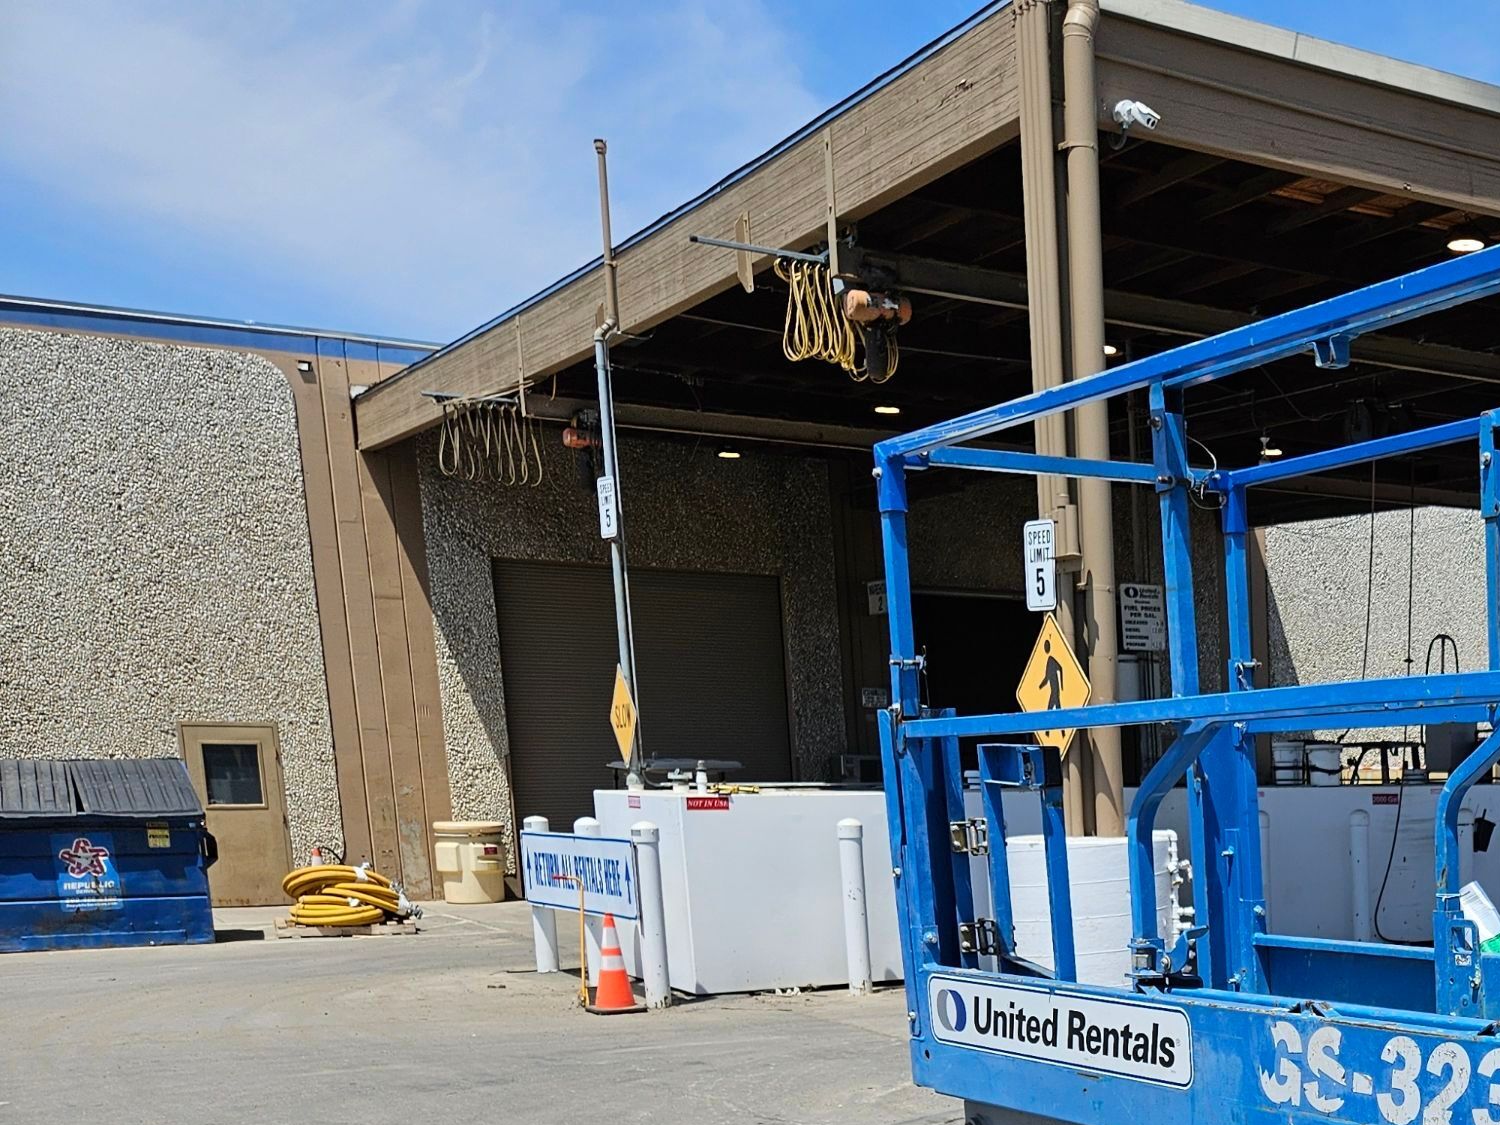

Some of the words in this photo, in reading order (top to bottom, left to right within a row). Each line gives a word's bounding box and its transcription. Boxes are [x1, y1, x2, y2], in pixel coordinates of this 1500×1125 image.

[600, 483, 613, 495] SPEED
[600, 493, 614, 506] LIMIT
[605, 508, 612, 528] 5
[1028, 529, 1051, 546] SPEED
[1029, 547, 1050, 563] LIMIT
[1036, 567, 1046, 597] 5
[614, 703, 632, 730] SLOW
[687, 799, 703, 808] NOT
[703, 799, 714, 808] IN
[533, 851, 560, 889] RETURN
[560, 853, 575, 890] ALL
[573, 855, 604, 894] RENTALS
[603, 858, 623, 898] HERE
[973, 996, 1059, 1048] United
[1067, 1009, 1176, 1069] Rentals
